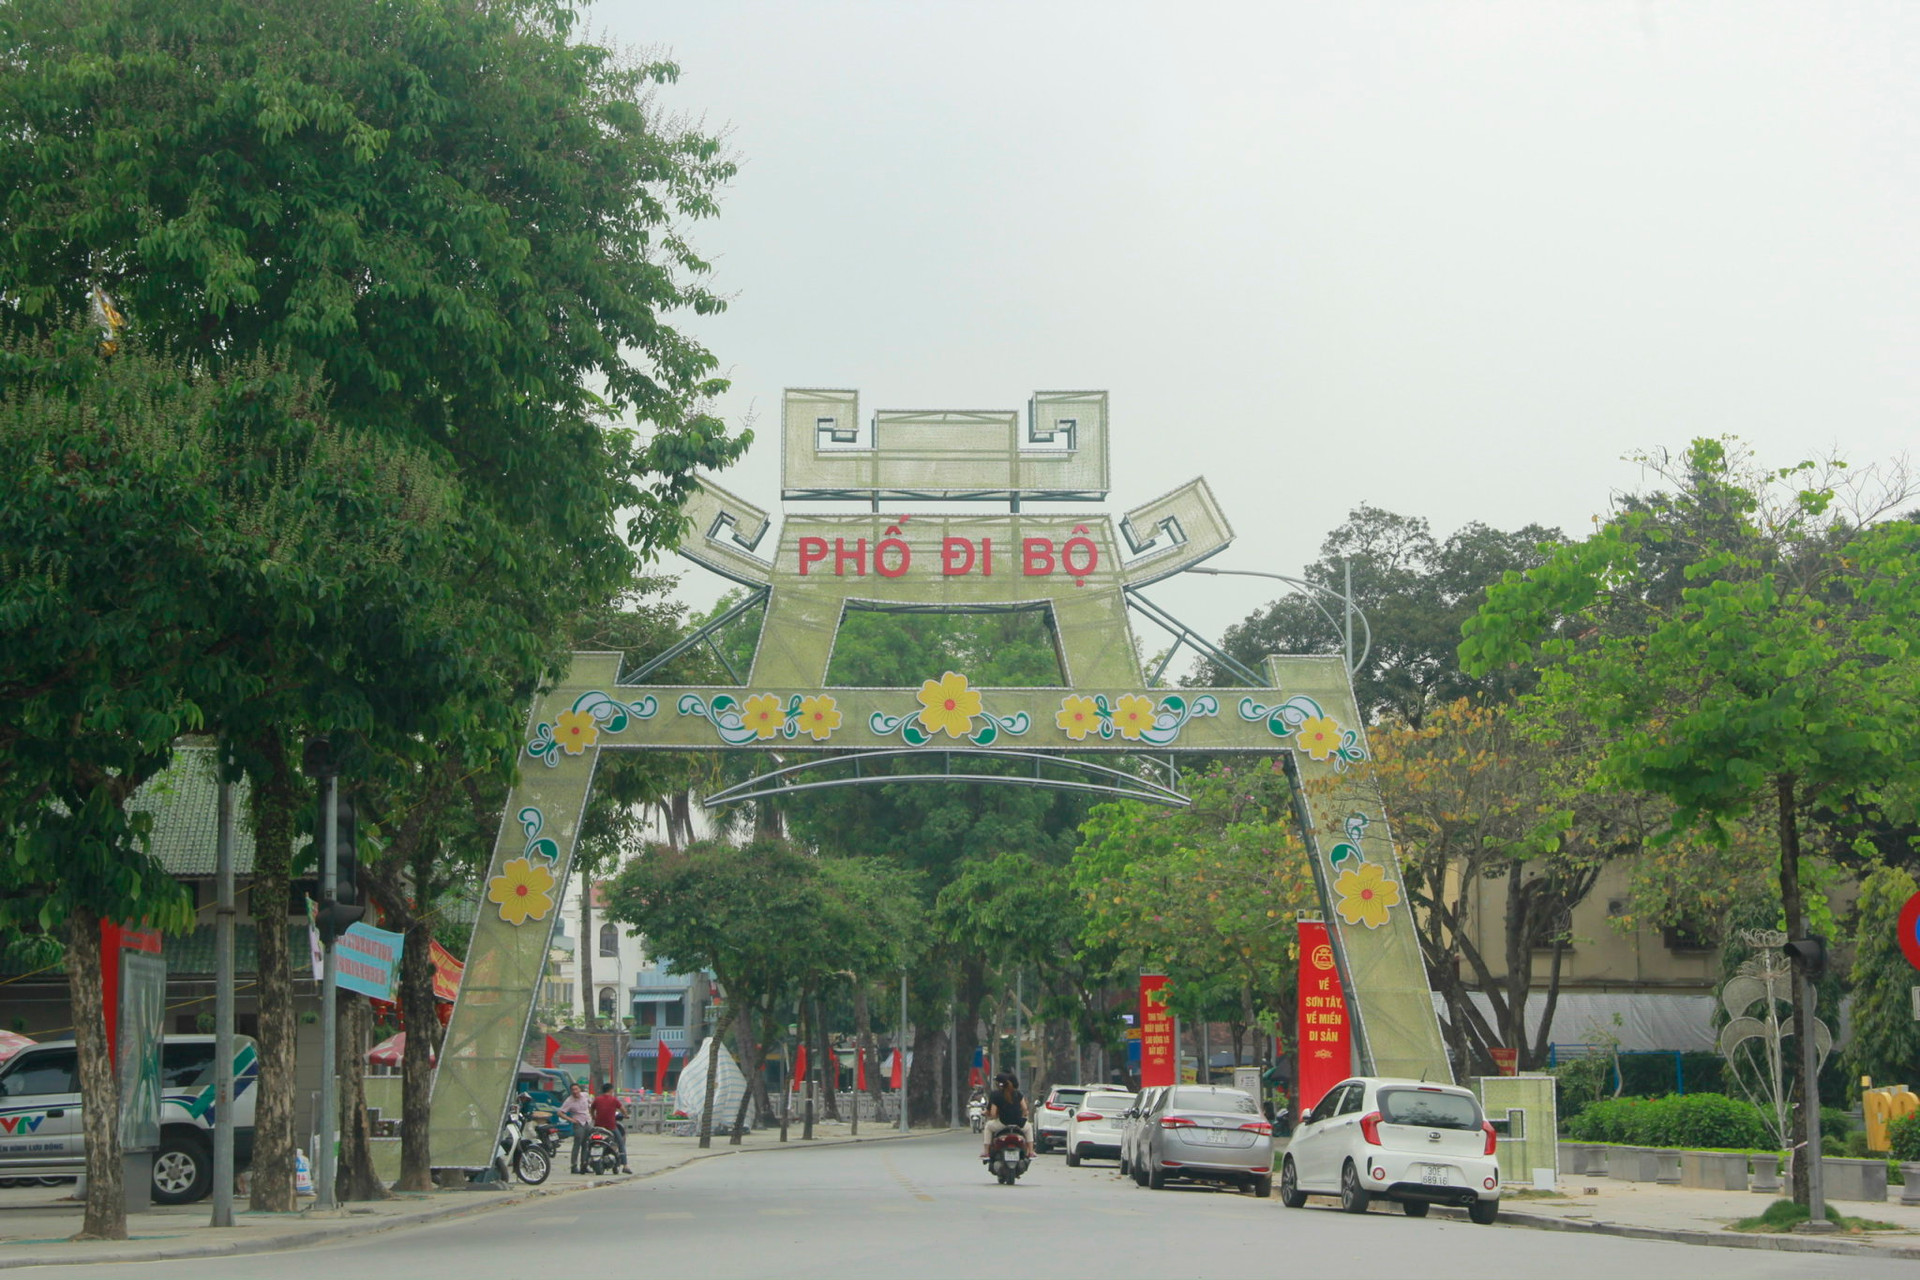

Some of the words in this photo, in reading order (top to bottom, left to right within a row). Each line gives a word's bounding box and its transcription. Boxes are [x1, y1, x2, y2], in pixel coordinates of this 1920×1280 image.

[798, 514, 911, 577] PHỐ
[940, 537, 992, 576] ĐI
[1023, 524, 1098, 587] BỘ
[1319, 977, 1330, 990] VỀ
[1306, 995, 1323, 1008] SƠN
[1306, 1011, 1317, 1024] VỀ
[1309, 1030, 1318, 1041] DI
[0, 1115, 45, 1135] VTV
